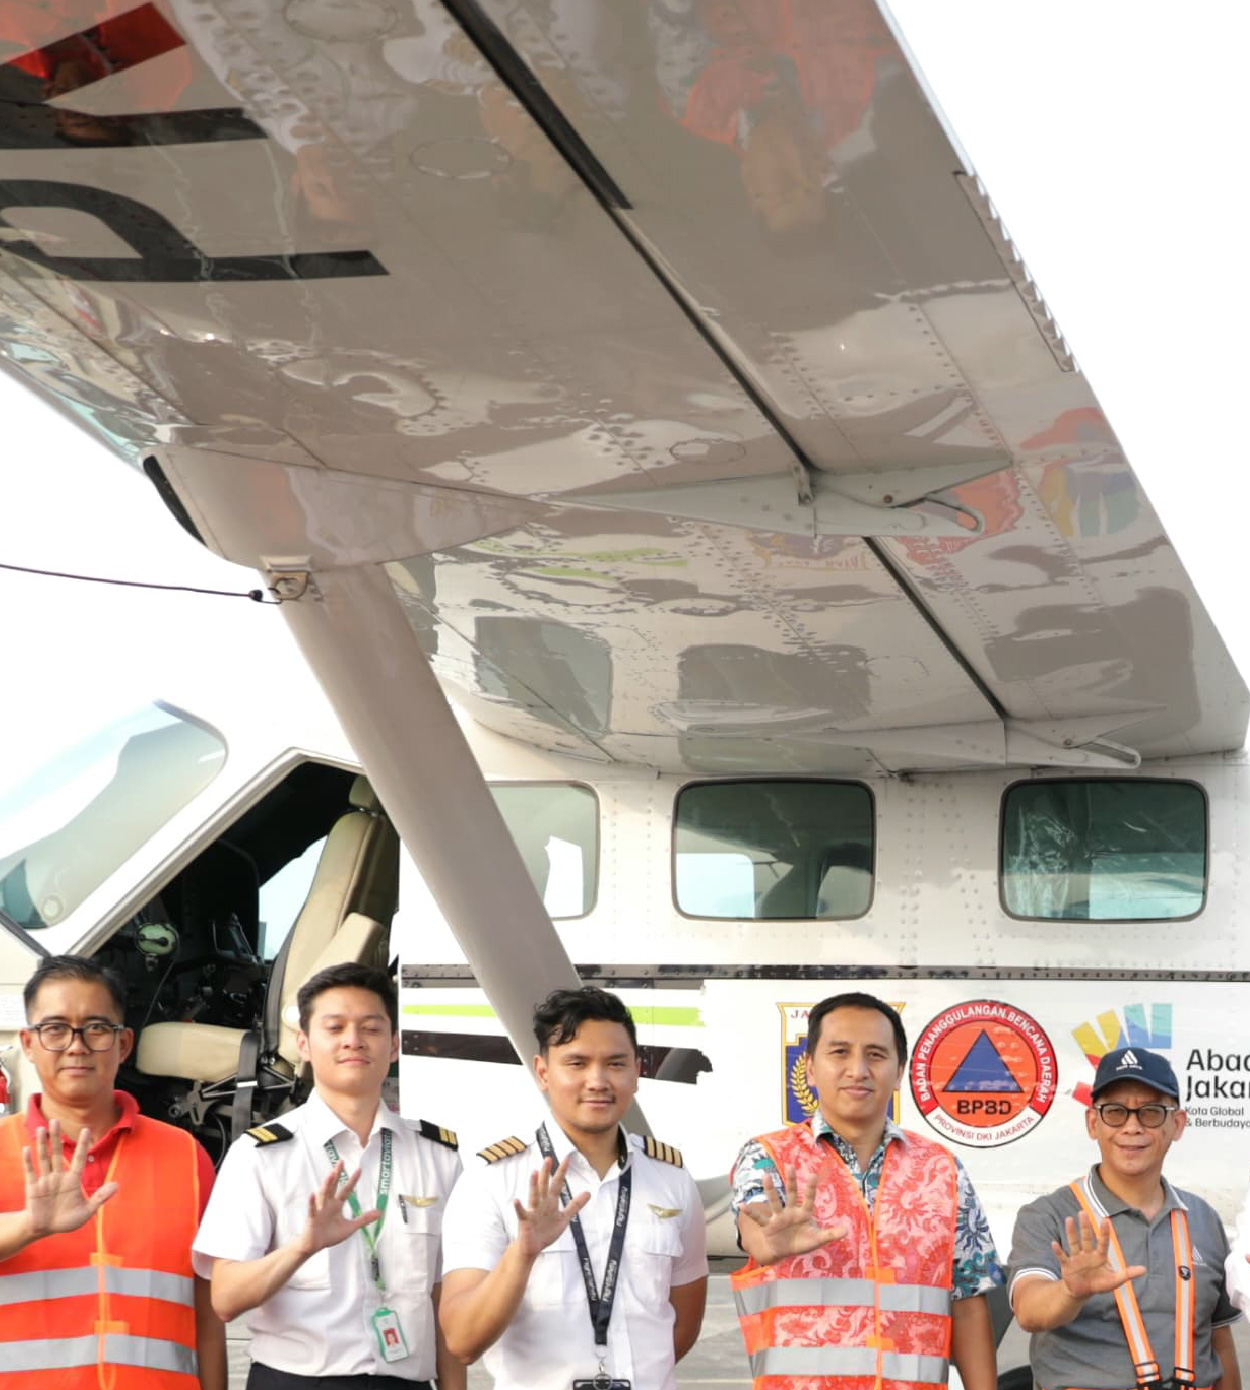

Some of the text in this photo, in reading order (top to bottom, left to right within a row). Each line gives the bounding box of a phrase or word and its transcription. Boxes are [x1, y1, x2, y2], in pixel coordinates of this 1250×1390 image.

[915, 1004, 1052, 1103] BADAN PENANGGULANGAN BENCANA DAERAH
[956, 1099, 1012, 1115] BPBD
[1184, 1106, 1245, 1116] Kota Global
[933, 1114, 1035, 1141] PROVINSI DKI JAKARTA
